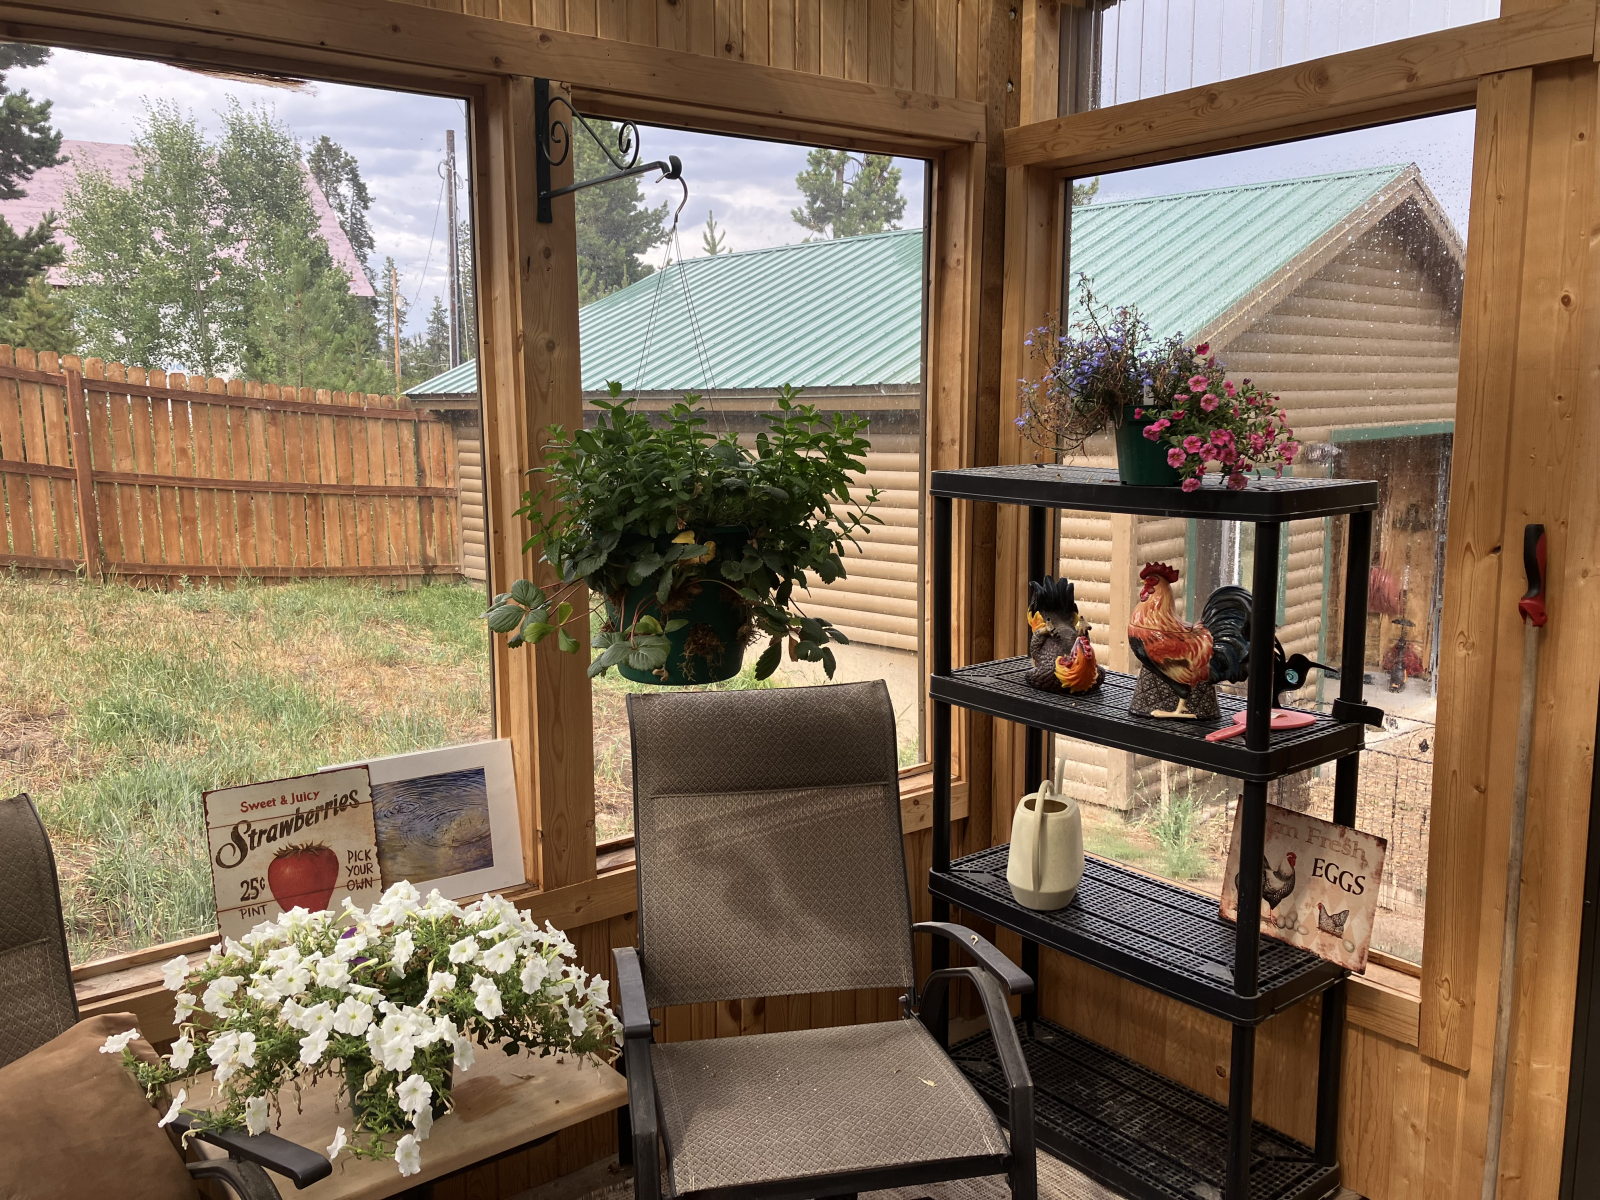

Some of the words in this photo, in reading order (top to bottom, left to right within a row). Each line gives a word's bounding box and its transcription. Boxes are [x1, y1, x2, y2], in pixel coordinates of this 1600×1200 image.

[240, 799, 278, 814] Sweet
[280, 795, 289, 805] &
[290, 790, 320, 806] Juicy
[215, 789, 361, 869] Strawberries
[1305, 825, 1368, 862] Fresh
[346, 849, 372, 864] PICK
[345, 862, 374, 877] YOUR
[1311, 857, 1366, 896] EGGS
[240, 876, 266, 902] 25¢
[346, 877, 373, 892] OWN
[240, 904, 268, 919] PINT
